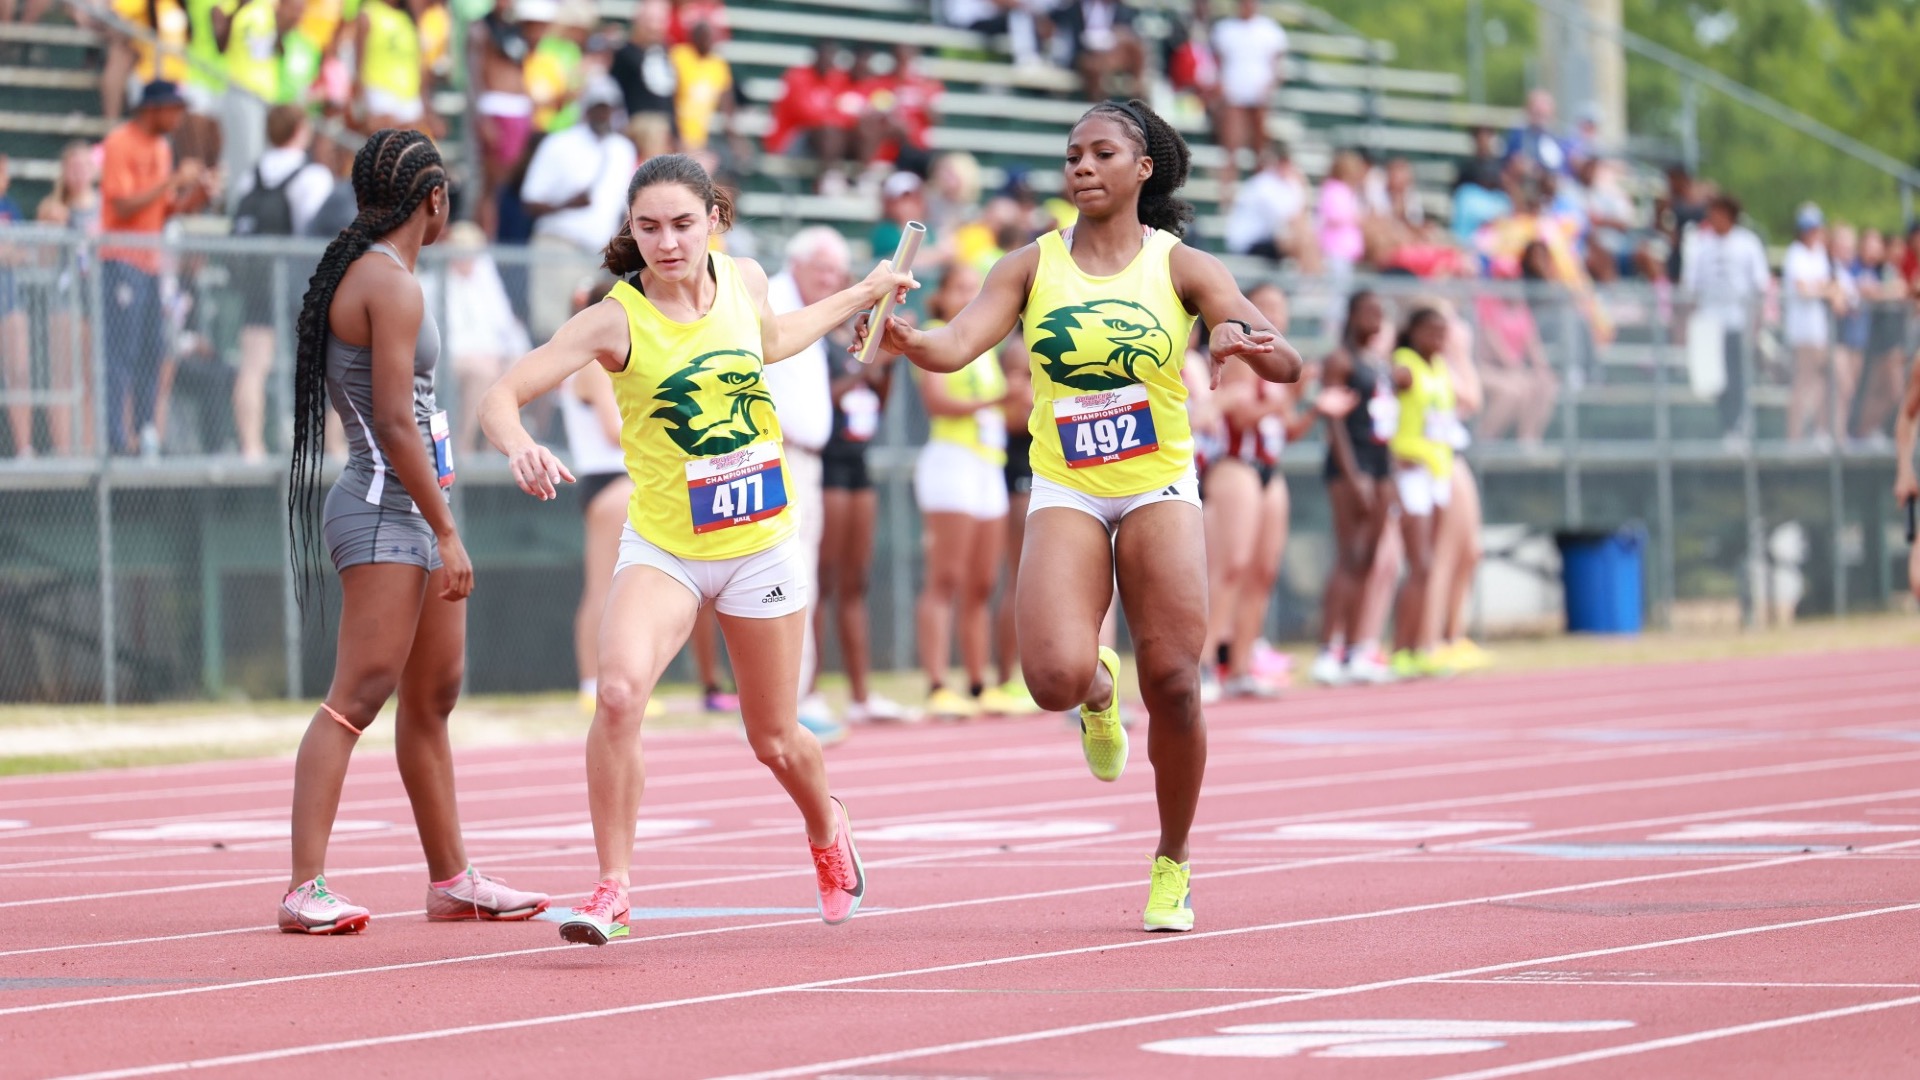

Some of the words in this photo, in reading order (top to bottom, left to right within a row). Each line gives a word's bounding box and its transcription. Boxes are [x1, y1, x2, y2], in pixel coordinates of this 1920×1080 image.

[1071, 405, 1132, 422] CHAMPIONSHIP
[1075, 414, 1140, 456] 492
[705, 463, 764, 484] CHAMPIONSHIP
[712, 473, 763, 518] 477
[761, 594, 786, 603] adidas
